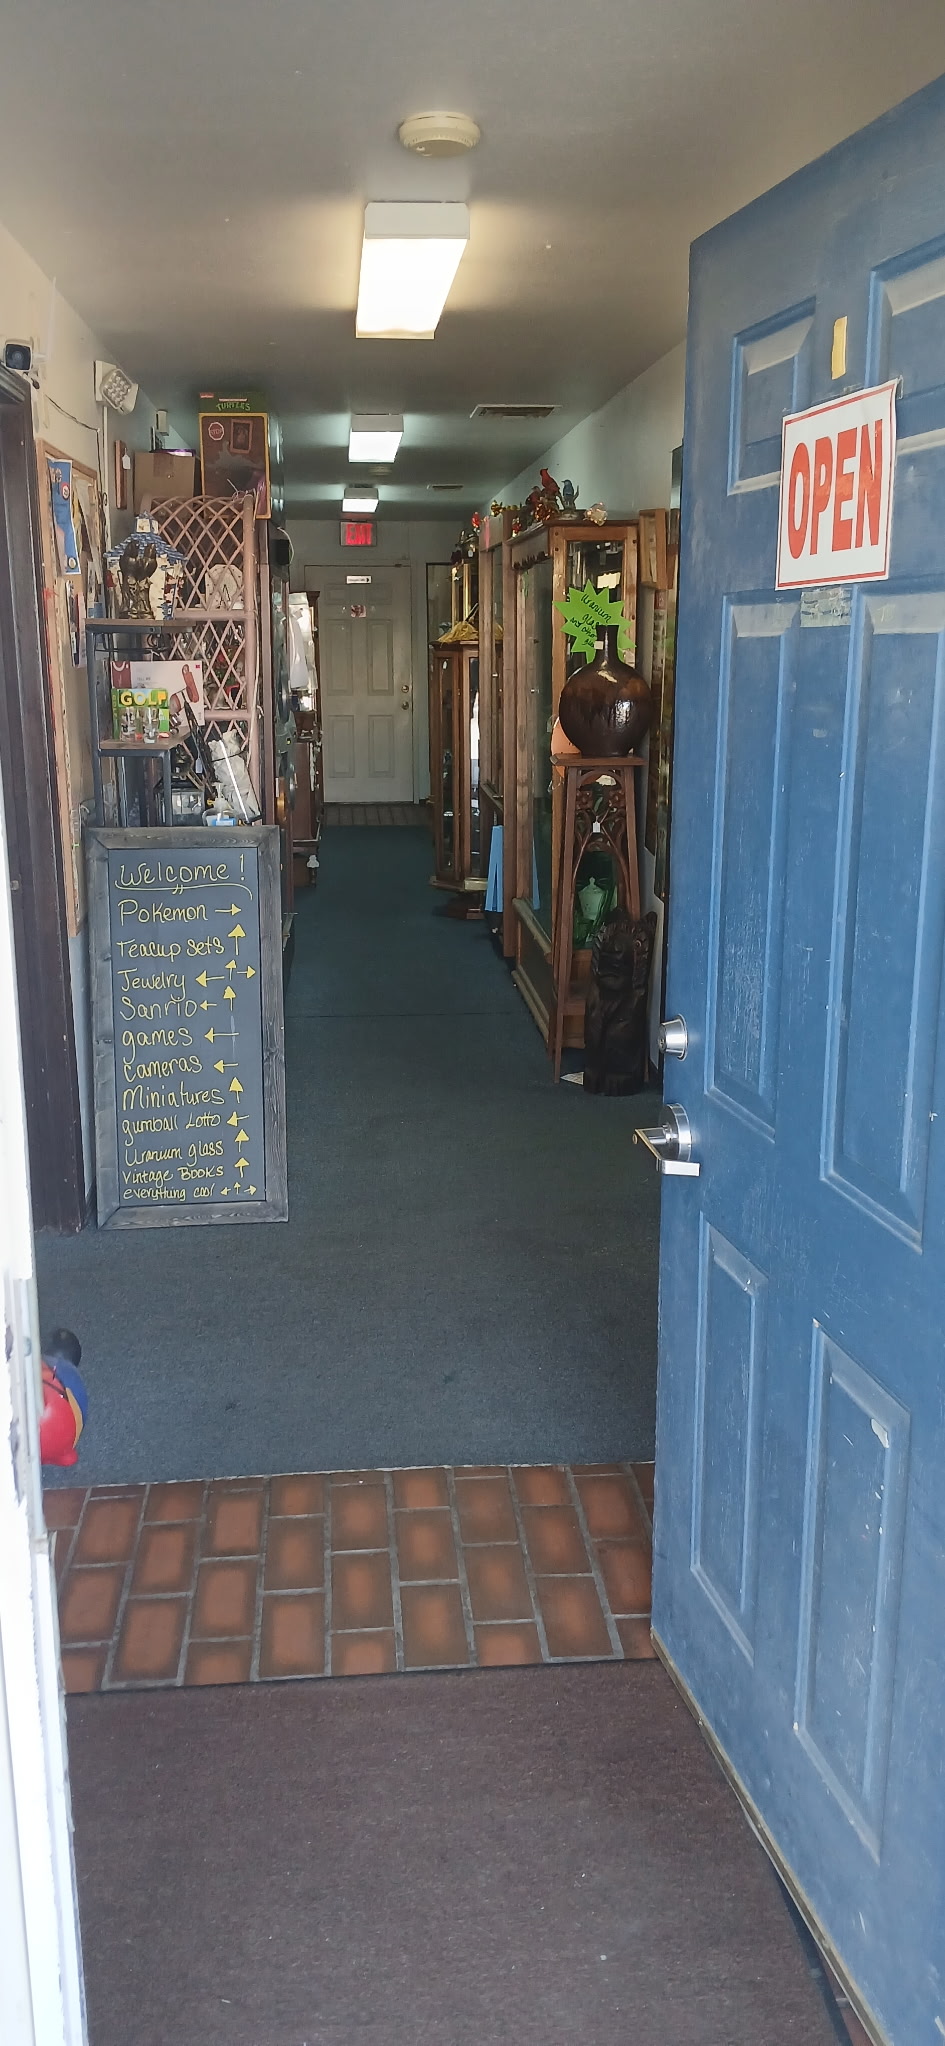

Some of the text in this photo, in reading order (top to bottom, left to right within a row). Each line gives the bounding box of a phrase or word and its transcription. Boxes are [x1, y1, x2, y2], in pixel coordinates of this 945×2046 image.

[216, 402, 251, 411] TURTLES
[788, 419, 883, 559] OPEN
[346, 523, 373, 545] EXIT
[581, 593, 612, 623] Uranium
[120, 690, 167, 706] GOLF
[120, 861, 230, 886] Welcome
[118, 899, 208, 926] Pokemon
[116, 938, 181, 962] Teacup
[117, 967, 186, 1002] Jewelry
[120, 996, 197, 1020] Sanrio
[122, 1027, 193, 1064] games
[123, 1081, 225, 1111] Miniatures
[122, 1111, 221, 1147] gumball Lotto
[125, 1140, 224, 1167] Uranium glass
[123, 1183, 215, 1201] everything cool
